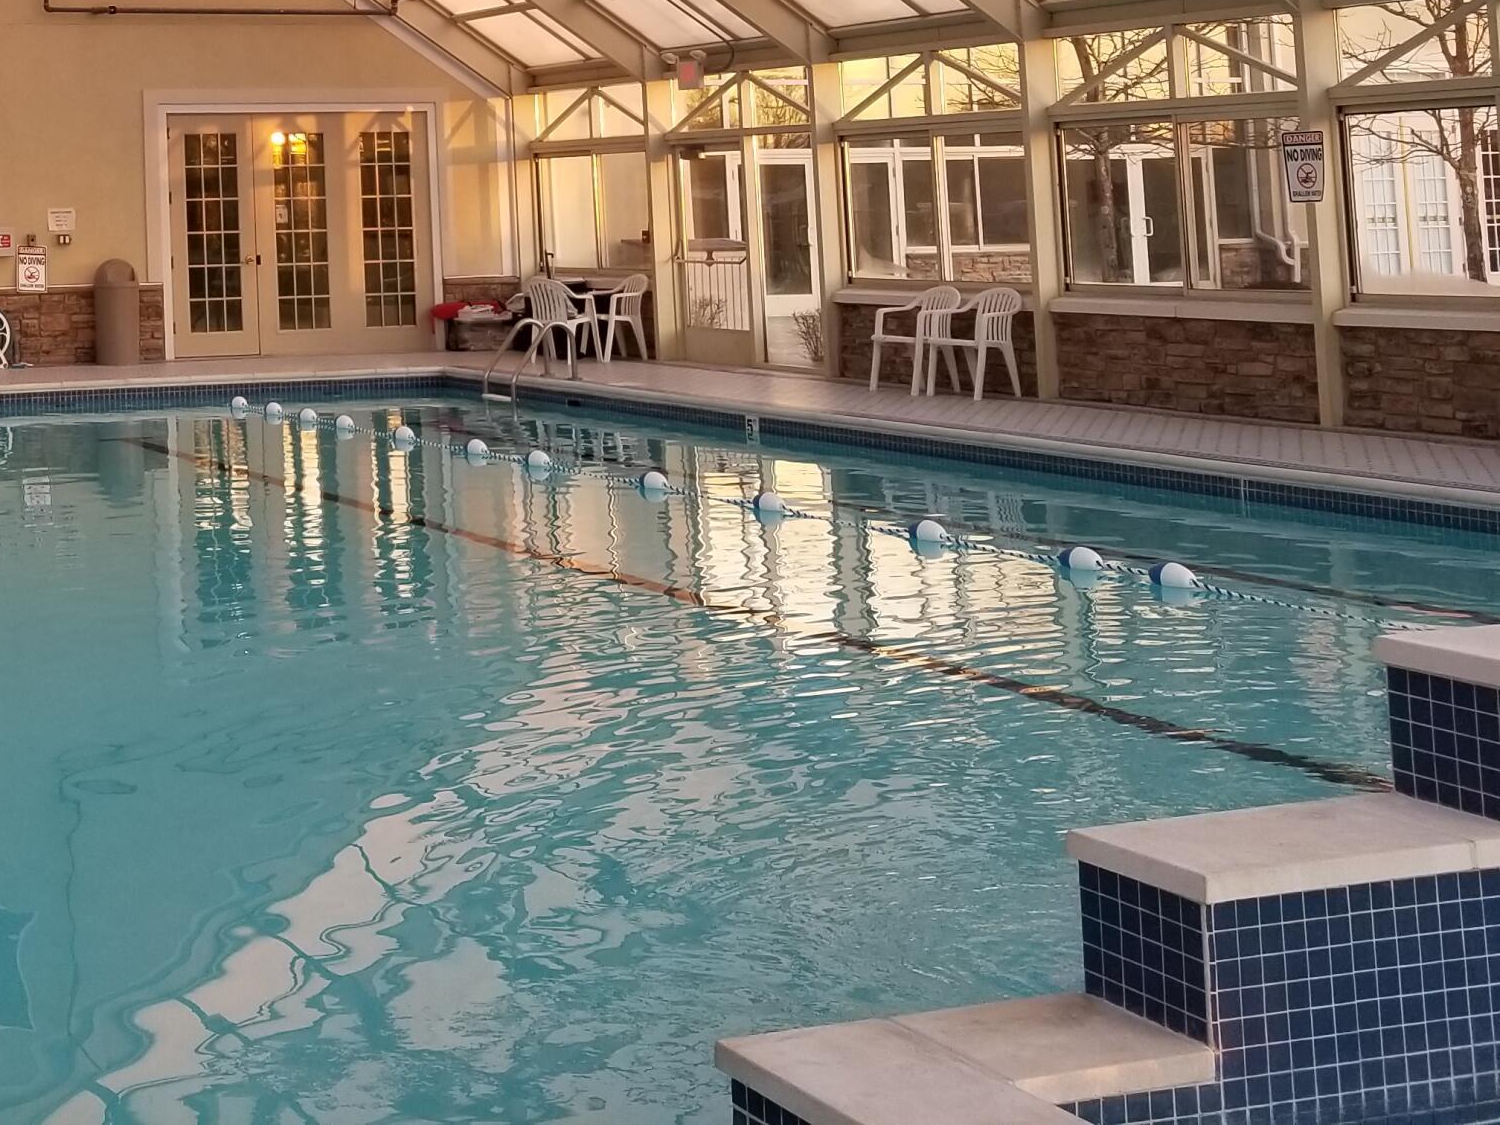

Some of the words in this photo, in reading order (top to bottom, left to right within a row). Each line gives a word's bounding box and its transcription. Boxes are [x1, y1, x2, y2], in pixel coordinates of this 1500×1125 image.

[1285, 134, 1321, 143] DANGER
[1286, 149, 1299, 162] NO
[1300, 148, 1322, 161] DIVING
[19, 257, 28, 265] NO
[28, 257, 45, 265] DIVING
